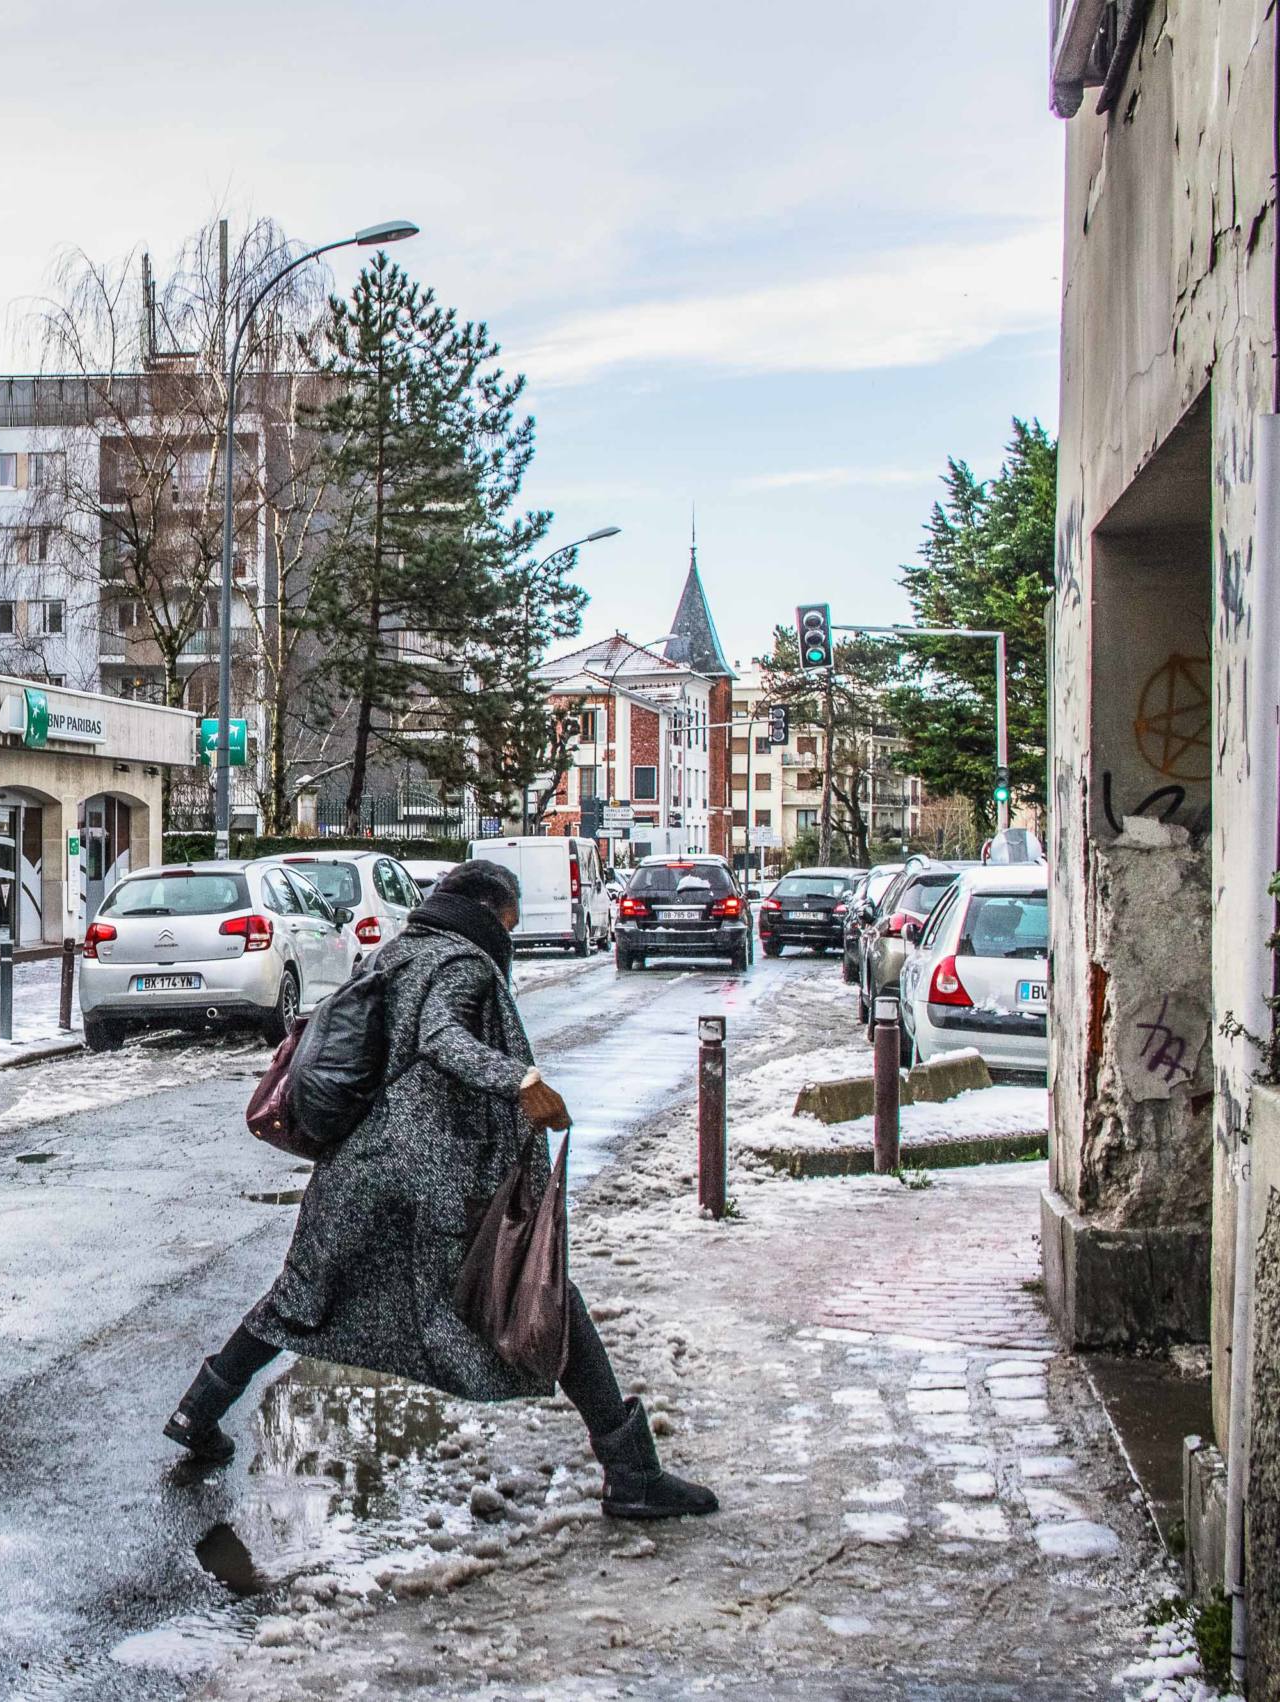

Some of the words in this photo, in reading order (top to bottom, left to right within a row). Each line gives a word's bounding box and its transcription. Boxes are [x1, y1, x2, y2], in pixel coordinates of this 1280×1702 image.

[47, 713, 66, 729] BNP
[67, 716, 102, 734] PARIBAS
[144, 976, 193, 989] BX-174-YN
